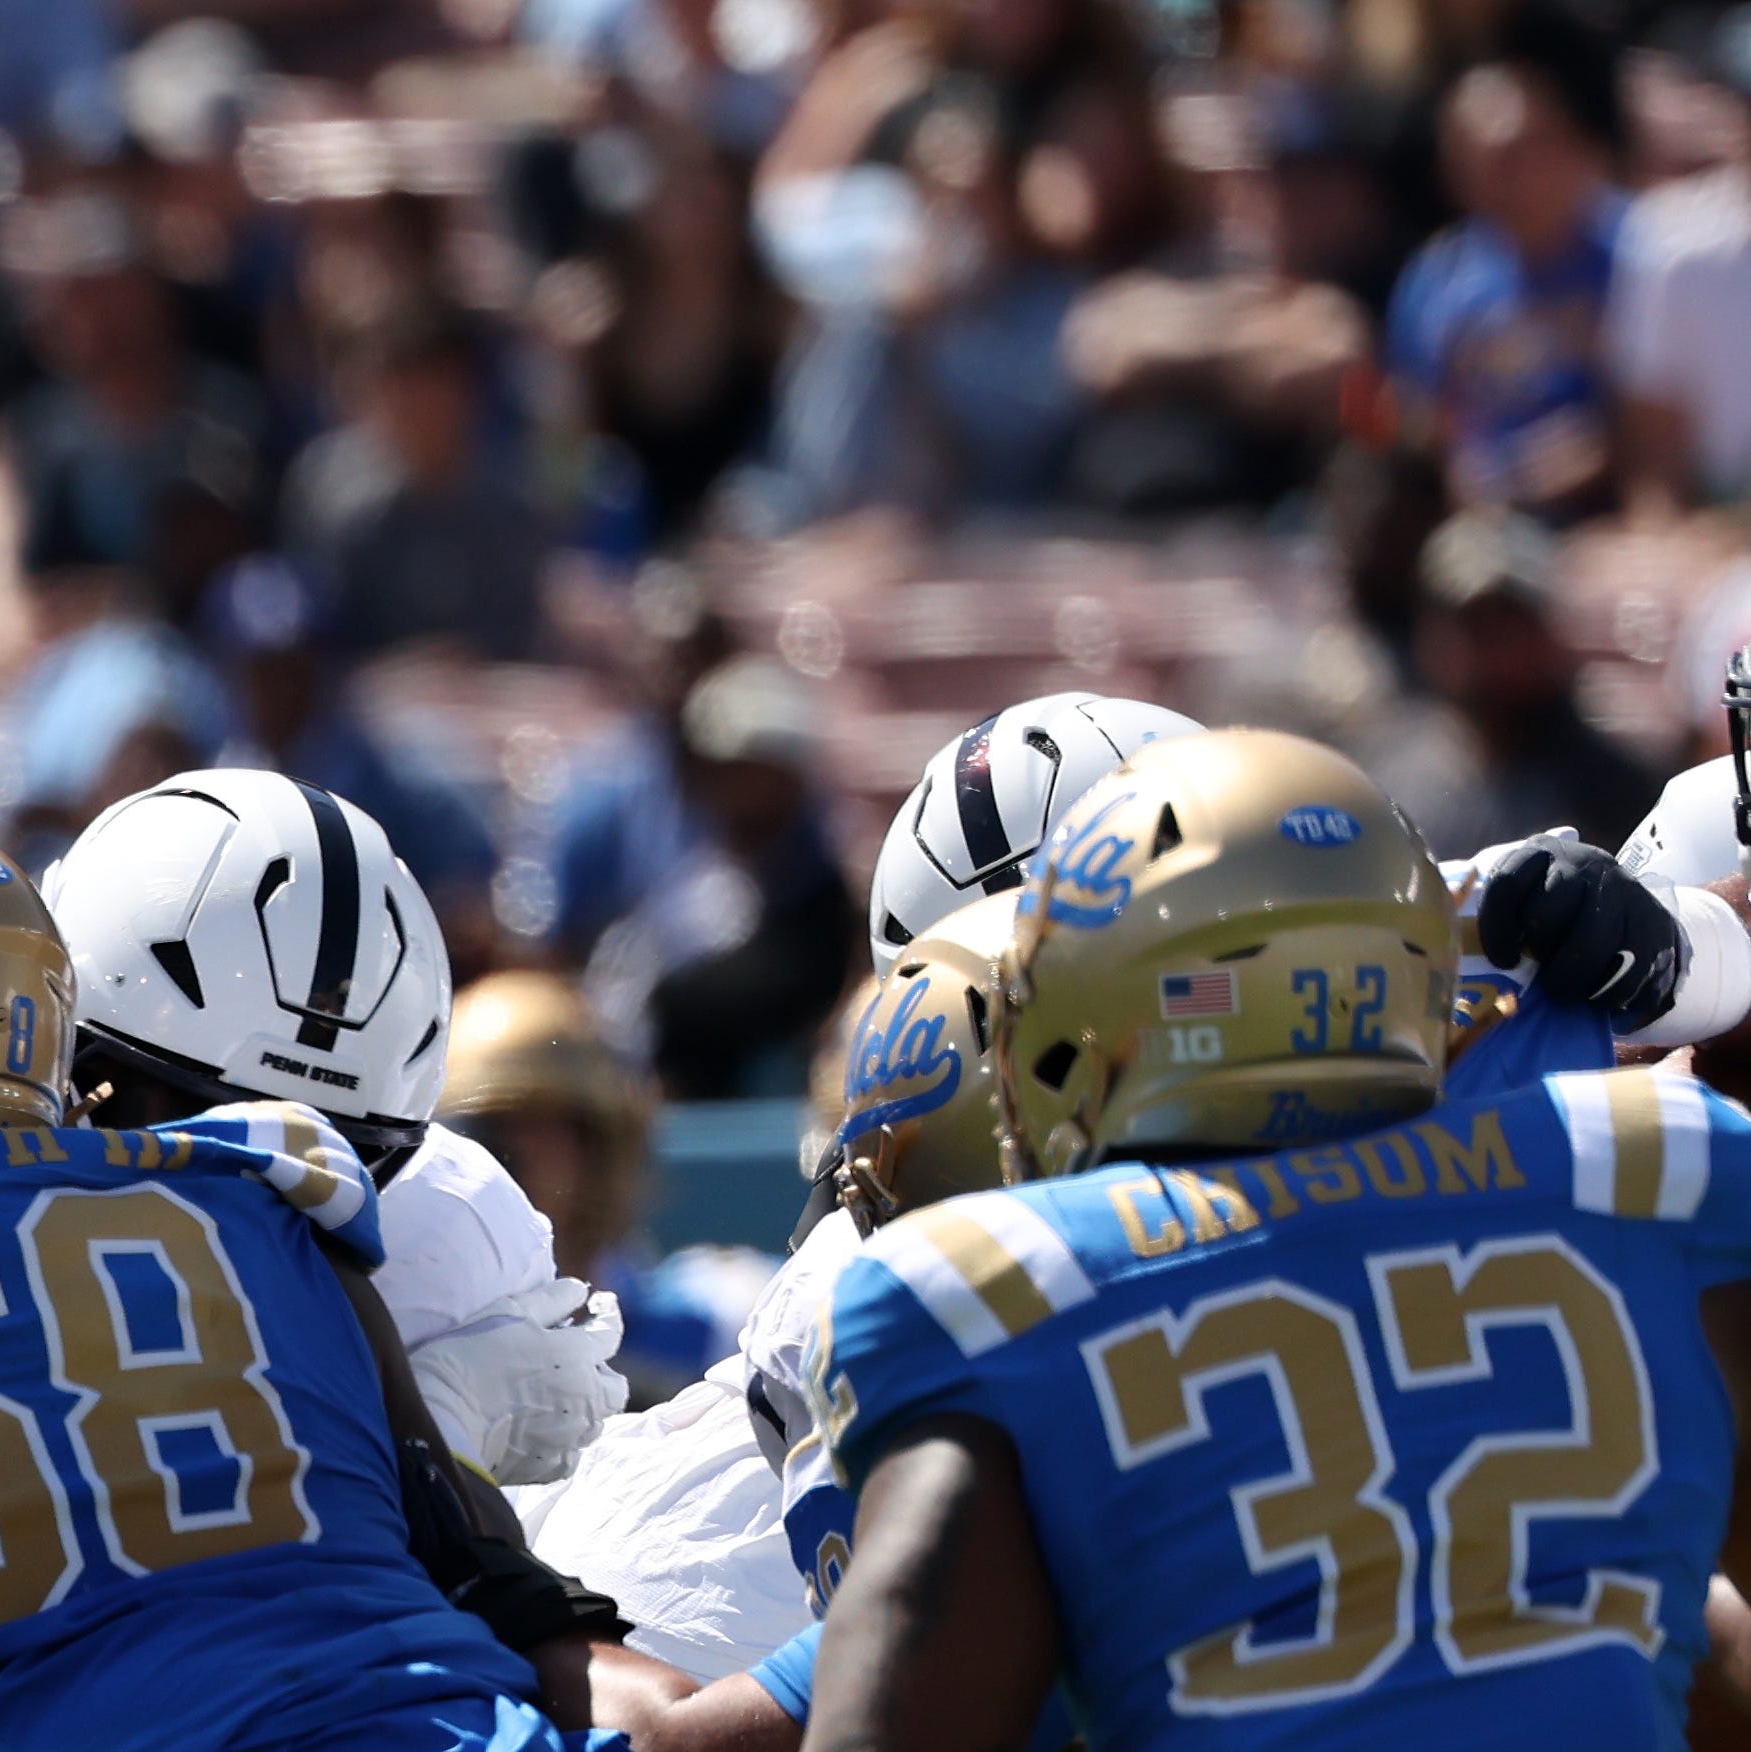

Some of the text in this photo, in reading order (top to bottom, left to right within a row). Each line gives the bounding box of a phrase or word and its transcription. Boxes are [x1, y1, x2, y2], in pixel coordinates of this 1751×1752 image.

[1291, 964, 1387, 1053] 32
[260, 1051, 361, 1091] PENN STATE
[1107, 1109, 1527, 1259] CHISOM
[1080, 1234, 1663, 1717] 32
